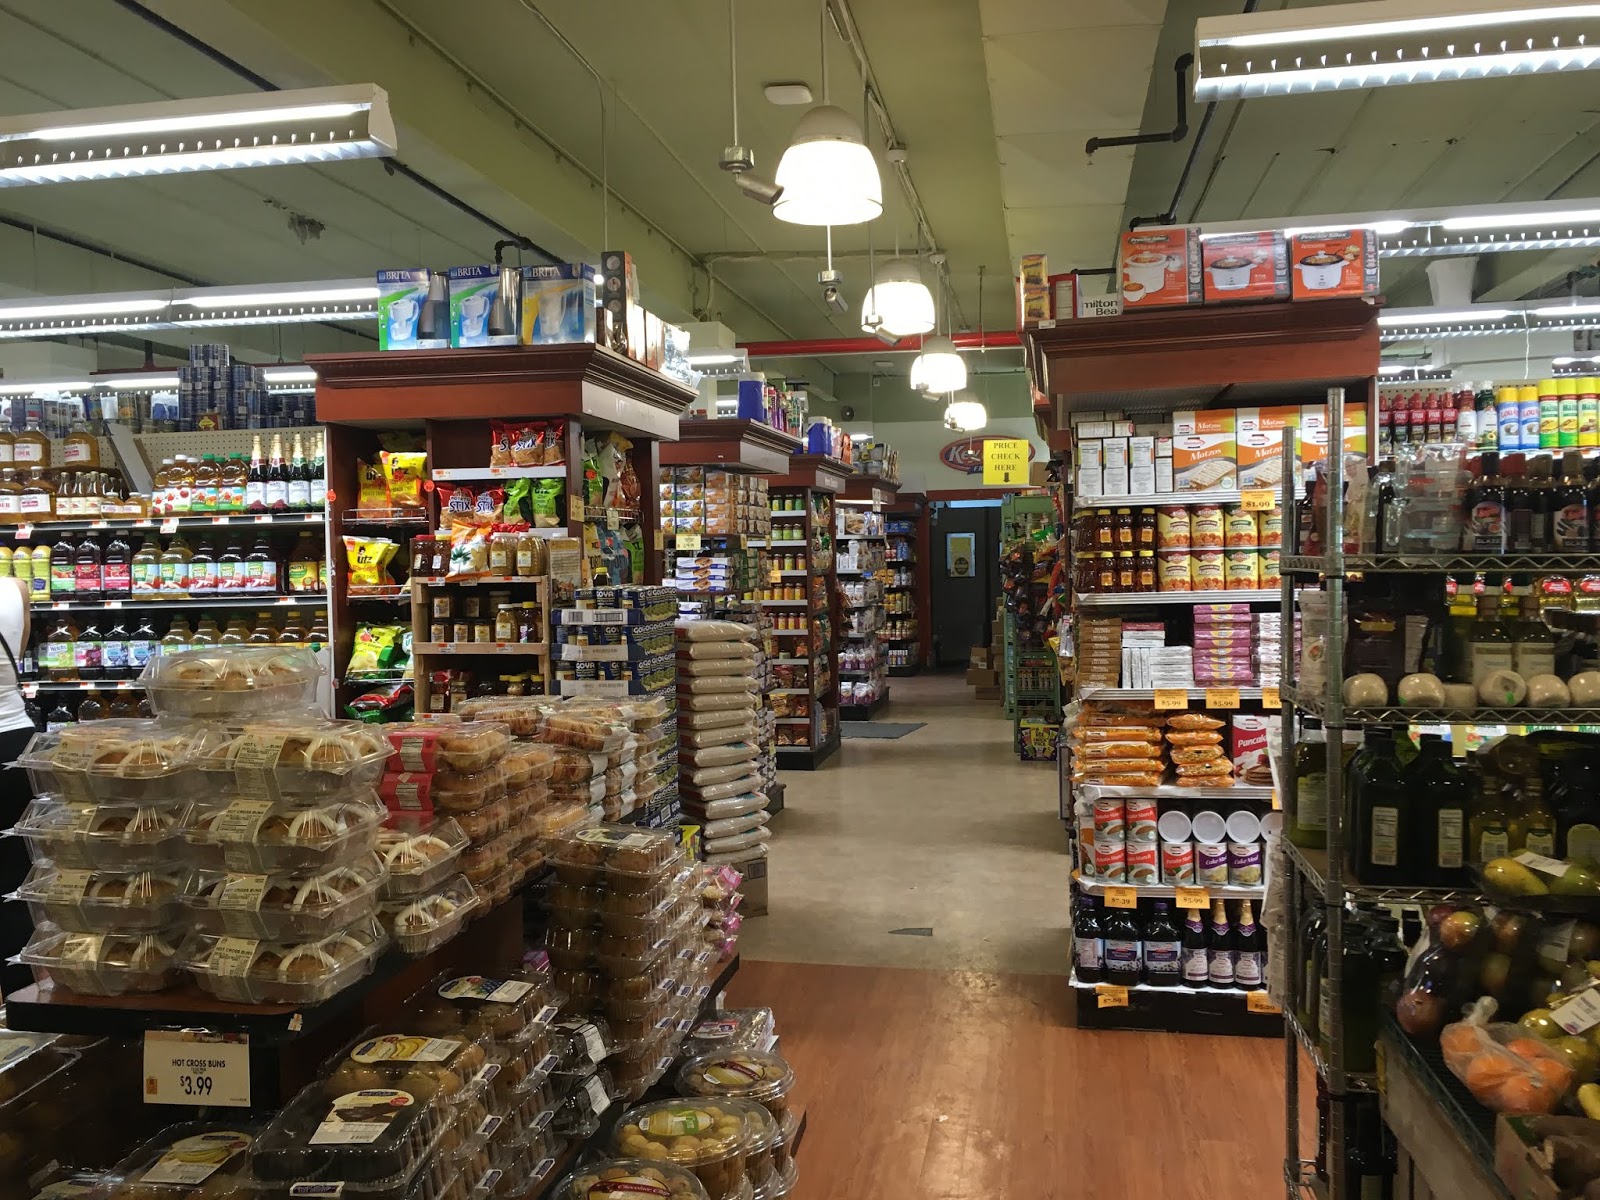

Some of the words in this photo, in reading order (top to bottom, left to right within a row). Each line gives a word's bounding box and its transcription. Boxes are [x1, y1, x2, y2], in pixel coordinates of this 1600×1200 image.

[386, 270, 411, 280] BRITA
[457, 265, 482, 277] BRITA
[532, 265, 561, 278] BRITA
[1189, 448, 1222, 461] Matzos
[1254, 447, 1282, 459] Matzo
[449, 500, 472, 514] STIX
[1245, 500, 1270, 508] $1.99
[1161, 699, 1181, 707] $5.99
[1213, 700, 1233, 708] $5.99
[1237, 735, 1267, 748] Pancak
[186, 1059, 207, 1068] CROSS
[208, 1060, 226, 1068] BUNS
[179, 1075, 213, 1096] $3.99
[617, 1184, 653, 1193] Chocolate
